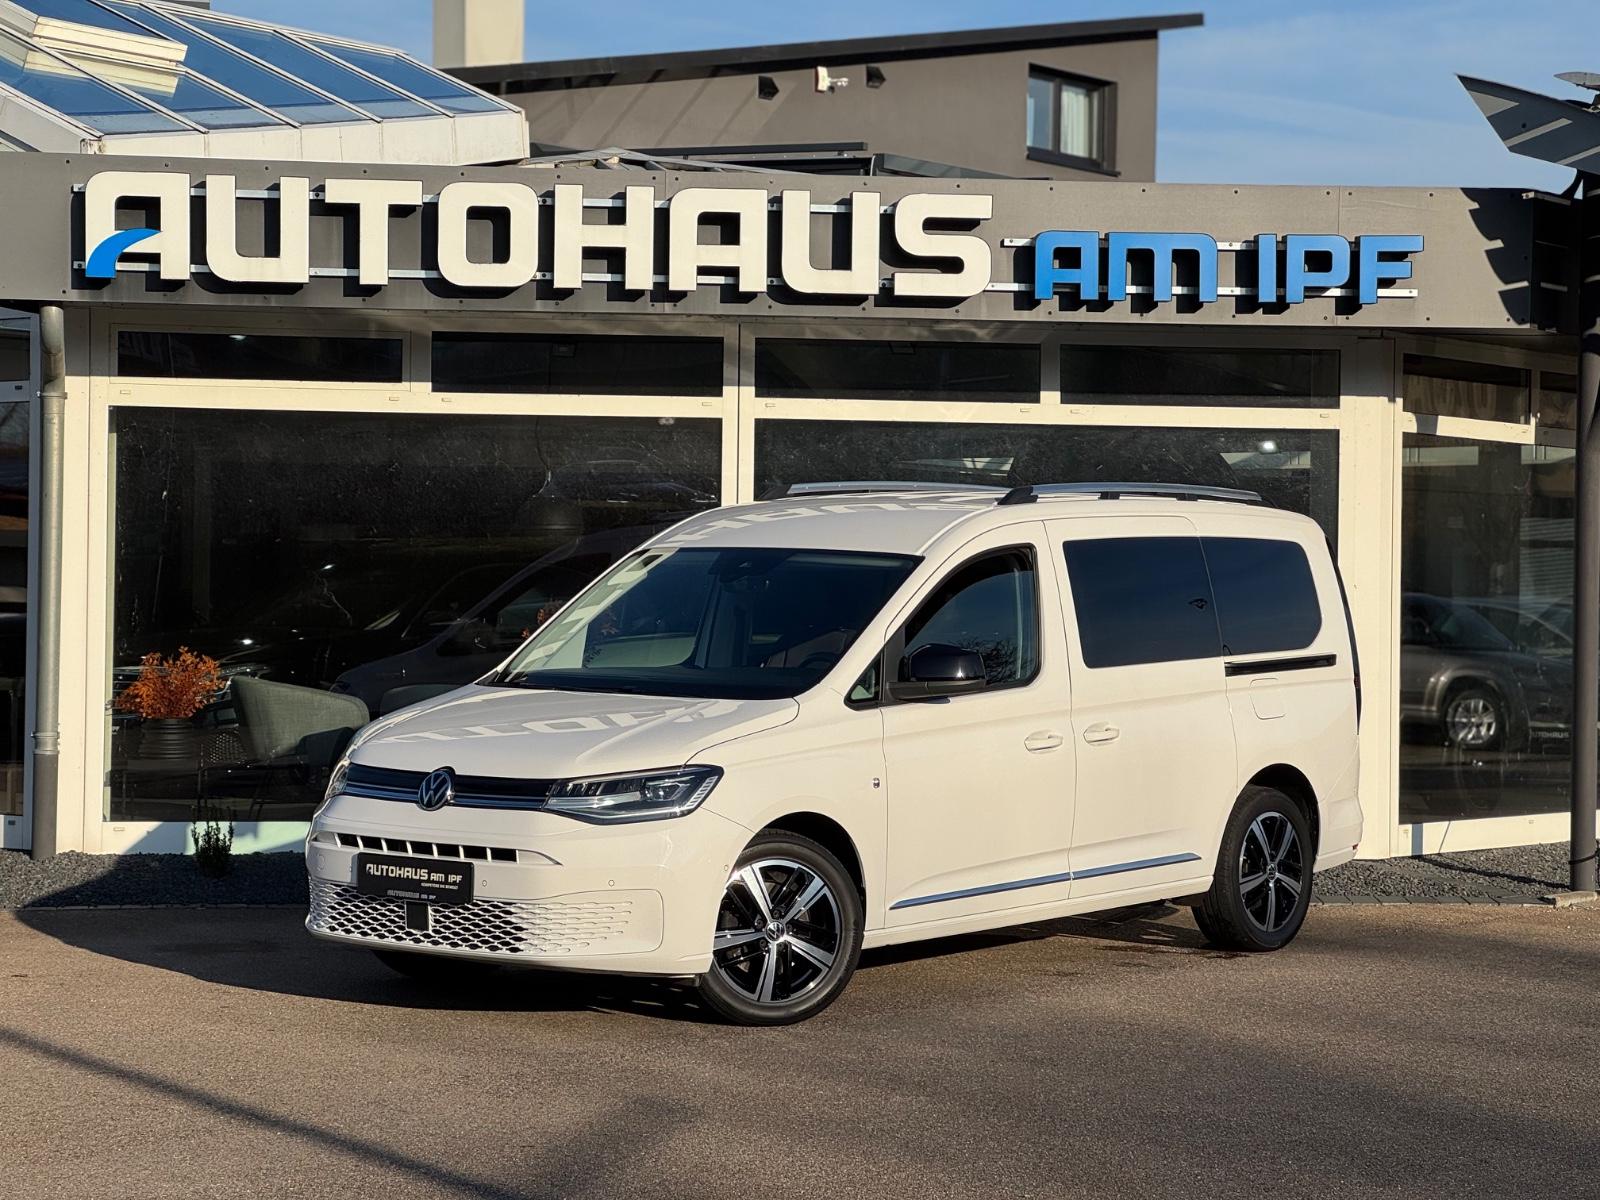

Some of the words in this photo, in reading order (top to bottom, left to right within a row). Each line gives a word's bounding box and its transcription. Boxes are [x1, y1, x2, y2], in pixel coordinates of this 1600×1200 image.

[85, 171, 993, 297] AUTOHAUS
[1034, 230, 1218, 302] AM
[1254, 233, 1424, 305] IPF
[366, 863, 429, 881] AUTOHAUS
[430, 872, 445, 882] AM
[448, 874, 463, 884] IPF
